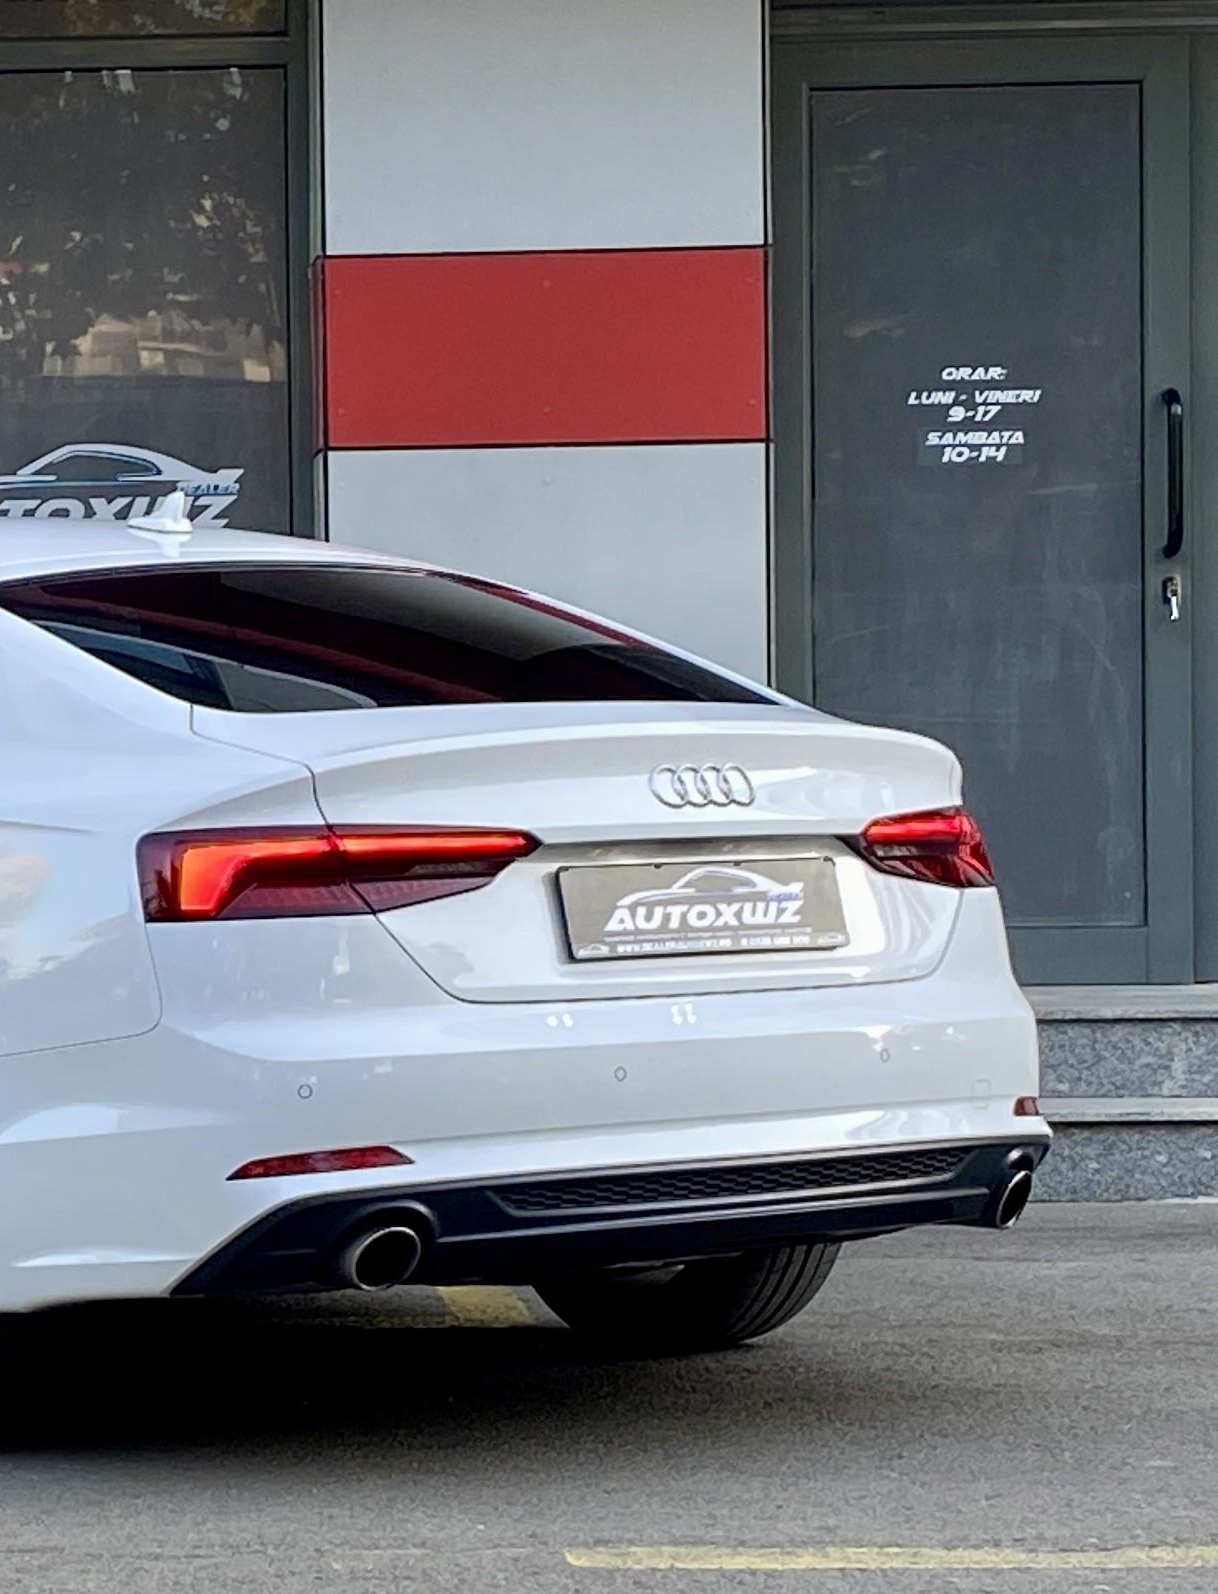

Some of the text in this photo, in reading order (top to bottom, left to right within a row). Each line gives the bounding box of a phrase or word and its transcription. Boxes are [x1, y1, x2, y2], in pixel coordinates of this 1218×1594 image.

[941, 366, 1008, 381] ORAR:
[907, 391, 956, 405] LUNI
[974, 389, 1042, 404] VINERI
[946, 405, 1003, 423] 9-17
[925, 430, 1025, 446] SAMBATA
[941, 446, 1008, 463] 10-14
